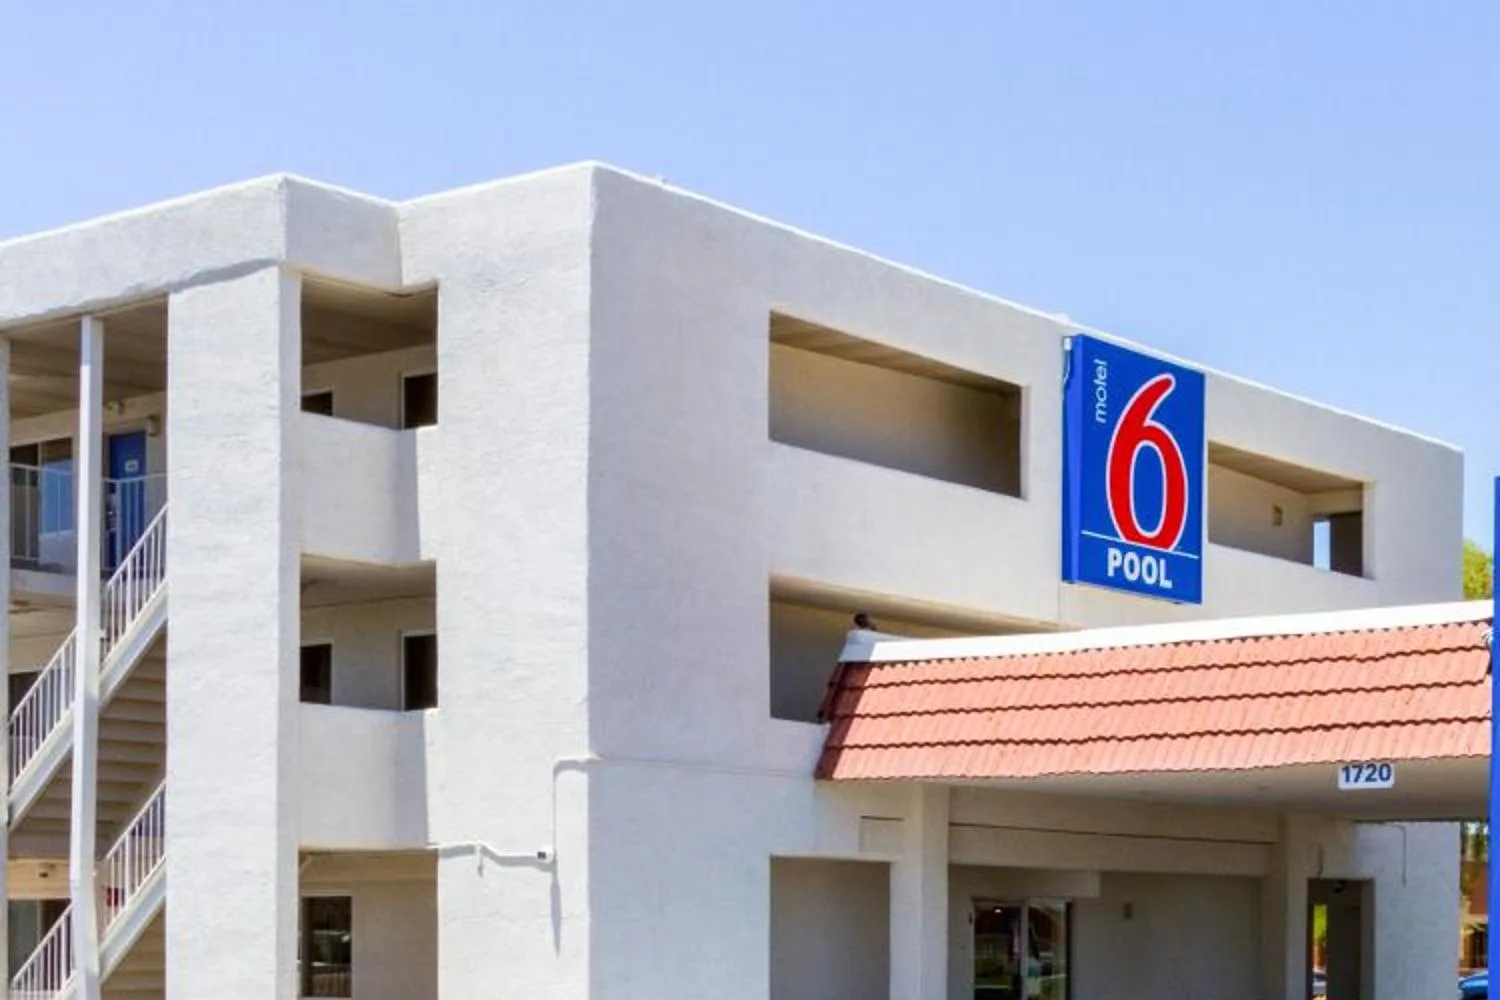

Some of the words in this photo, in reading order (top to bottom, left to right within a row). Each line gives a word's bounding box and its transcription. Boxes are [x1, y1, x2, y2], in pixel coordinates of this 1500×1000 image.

[1093, 358, 1108, 424] motel
[1106, 373, 1188, 552] 6
[1107, 547, 1173, 589] POOL
[1341, 763, 1392, 783] 1720
